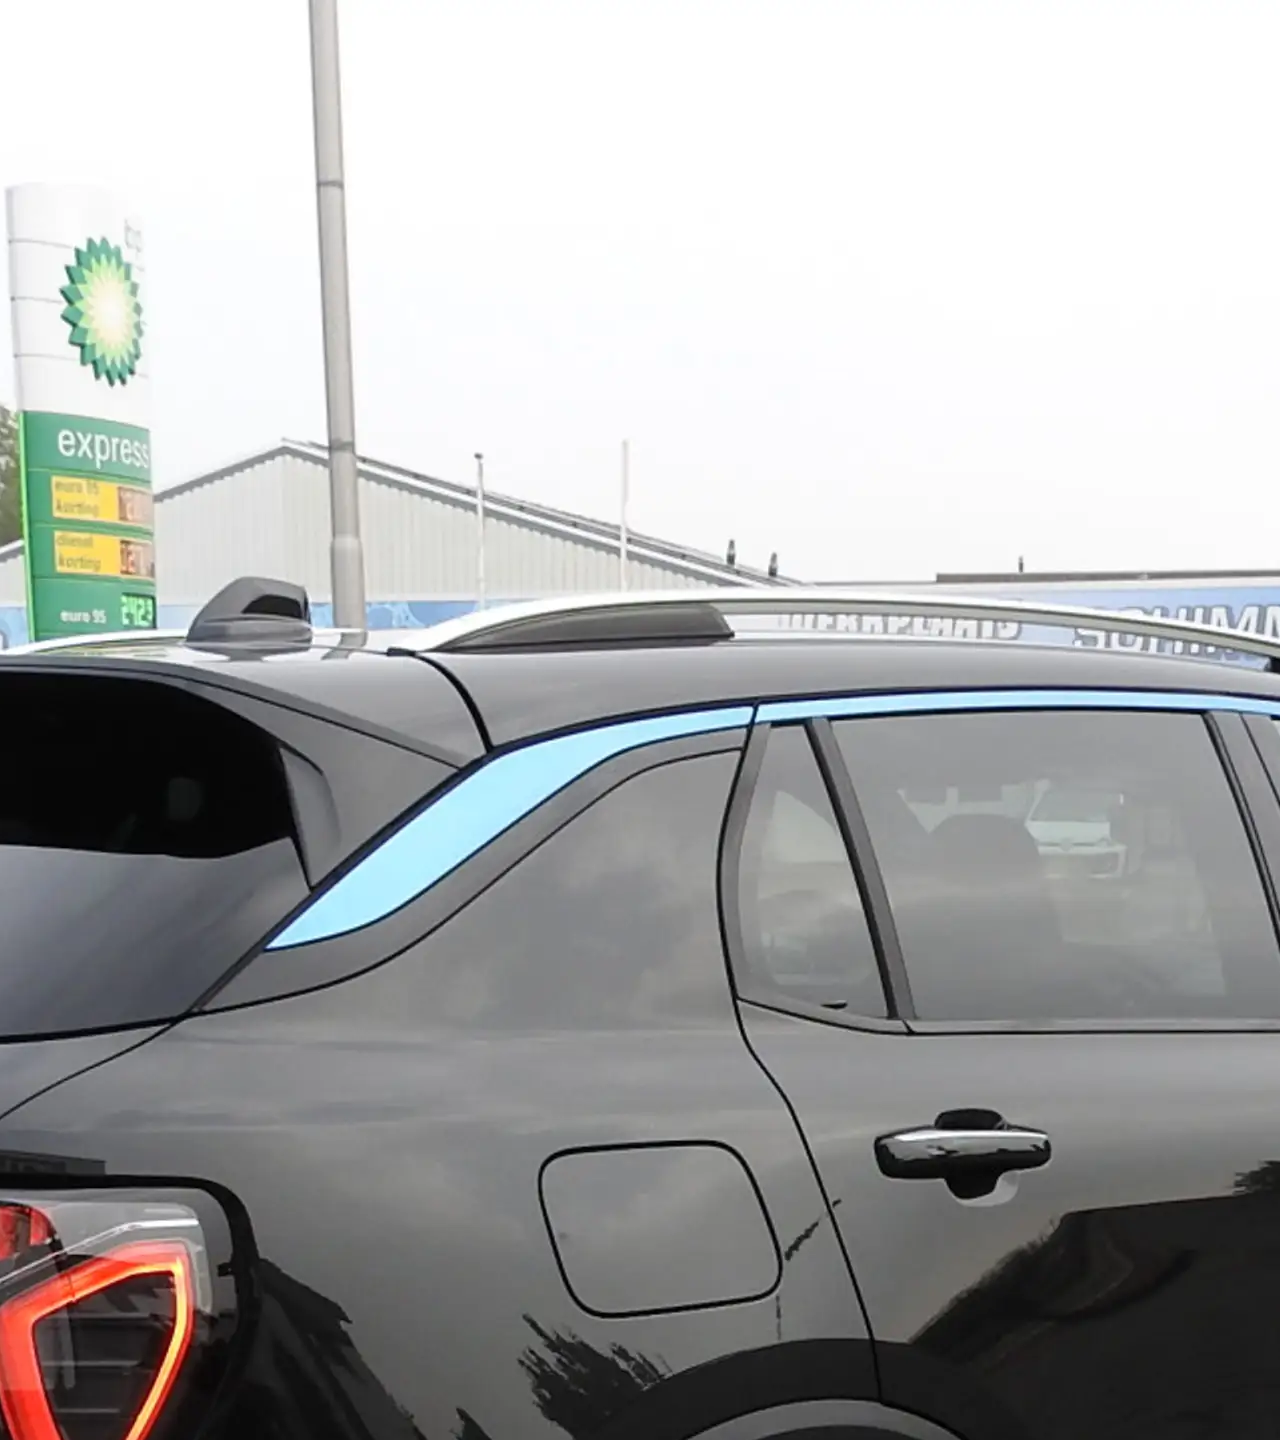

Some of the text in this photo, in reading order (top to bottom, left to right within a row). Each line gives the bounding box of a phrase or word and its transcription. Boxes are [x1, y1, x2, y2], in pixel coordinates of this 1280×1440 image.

[57, 429, 150, 470] express
[60, 609, 91, 623] euro
[91, 609, 107, 624] 95
